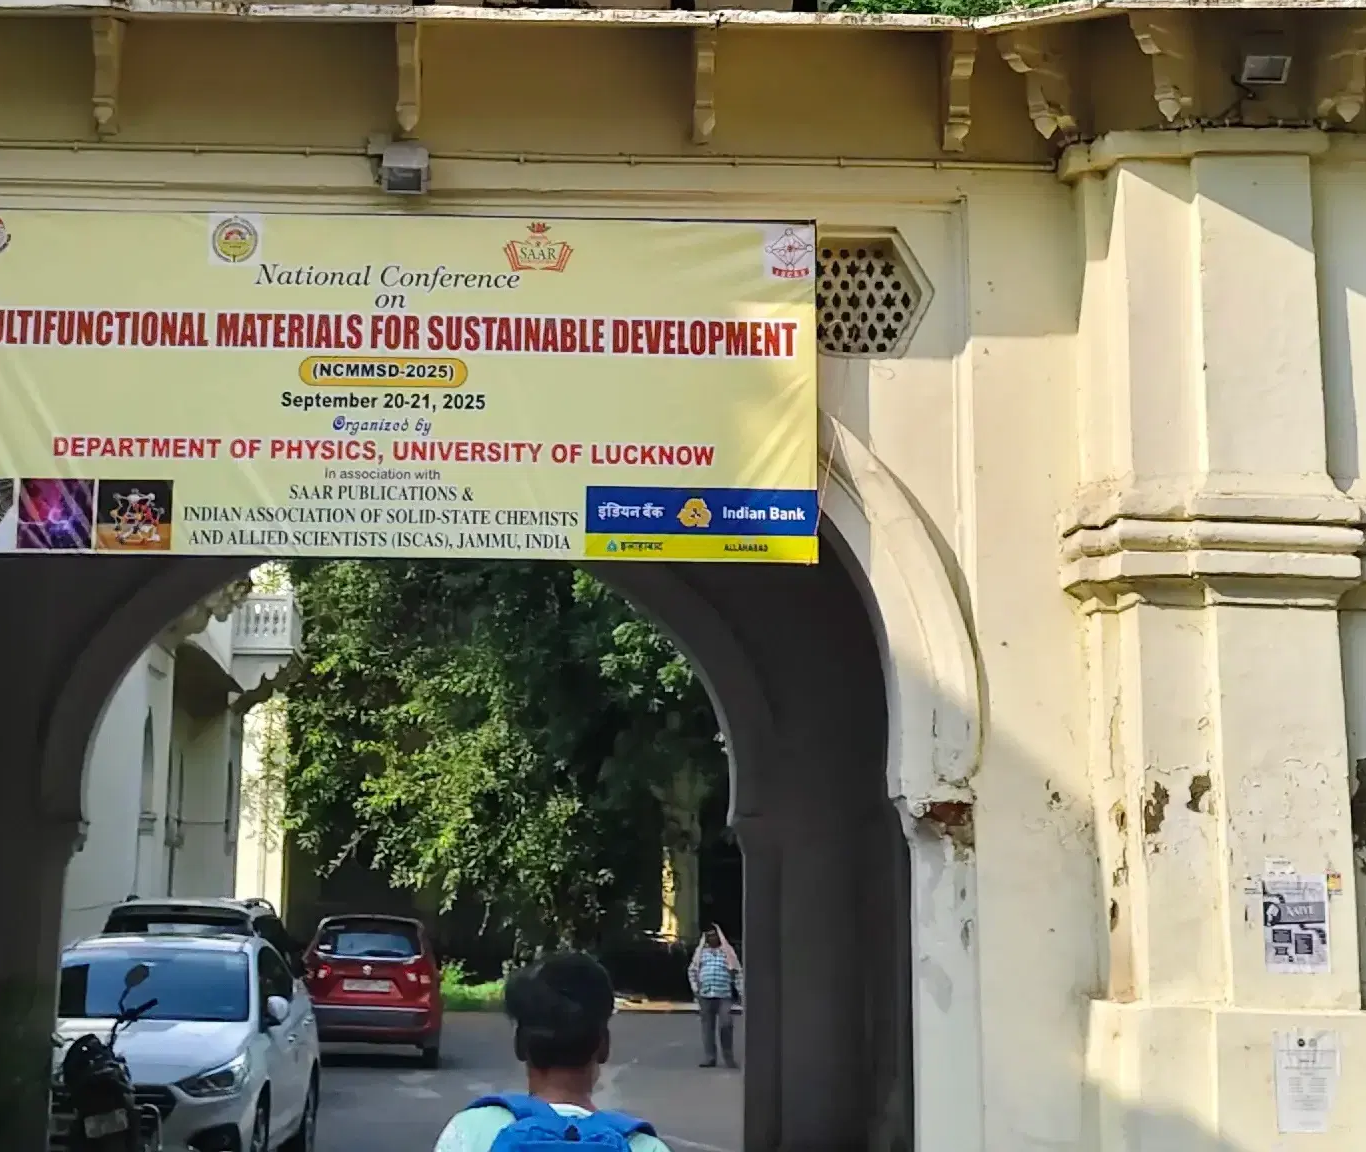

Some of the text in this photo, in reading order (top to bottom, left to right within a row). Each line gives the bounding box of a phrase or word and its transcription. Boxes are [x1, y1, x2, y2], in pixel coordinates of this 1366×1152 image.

[520, 247, 557, 260] SAAR
[254, 263, 521, 293] National Conference
[374, 293, 406, 309] on
[215, 312, 363, 349] MATERIALS
[370, 315, 420, 350] FOR
[427, 315, 605, 354] SUSTAINABLE
[612, 319, 798, 357] DEVELOPMENT
[312, 363, 454, 381] (NCMMSD-2025)
[281, 391, 486, 412] September 20-21, 2025
[332, 415, 432, 436] Organized by
[53, 436, 715, 466] DEPARTMENT OF PHYSICS, UNIVERSITY OF LUCKNOW
[324, 468, 441, 480] In association with
[289, 484, 474, 501] SAAR PUBLICATIONS &
[184, 506, 579, 528] INDIAN ASSOCIATION OF SOLID-STATE CHEMISTS
[597, 502, 665, 519] इंडियन बैंक
[723, 505, 806, 521] Indian Bank
[188, 529, 571, 551] AND ALLIED SCIENTISTS (ISCAS), JAMMU, INDIA
